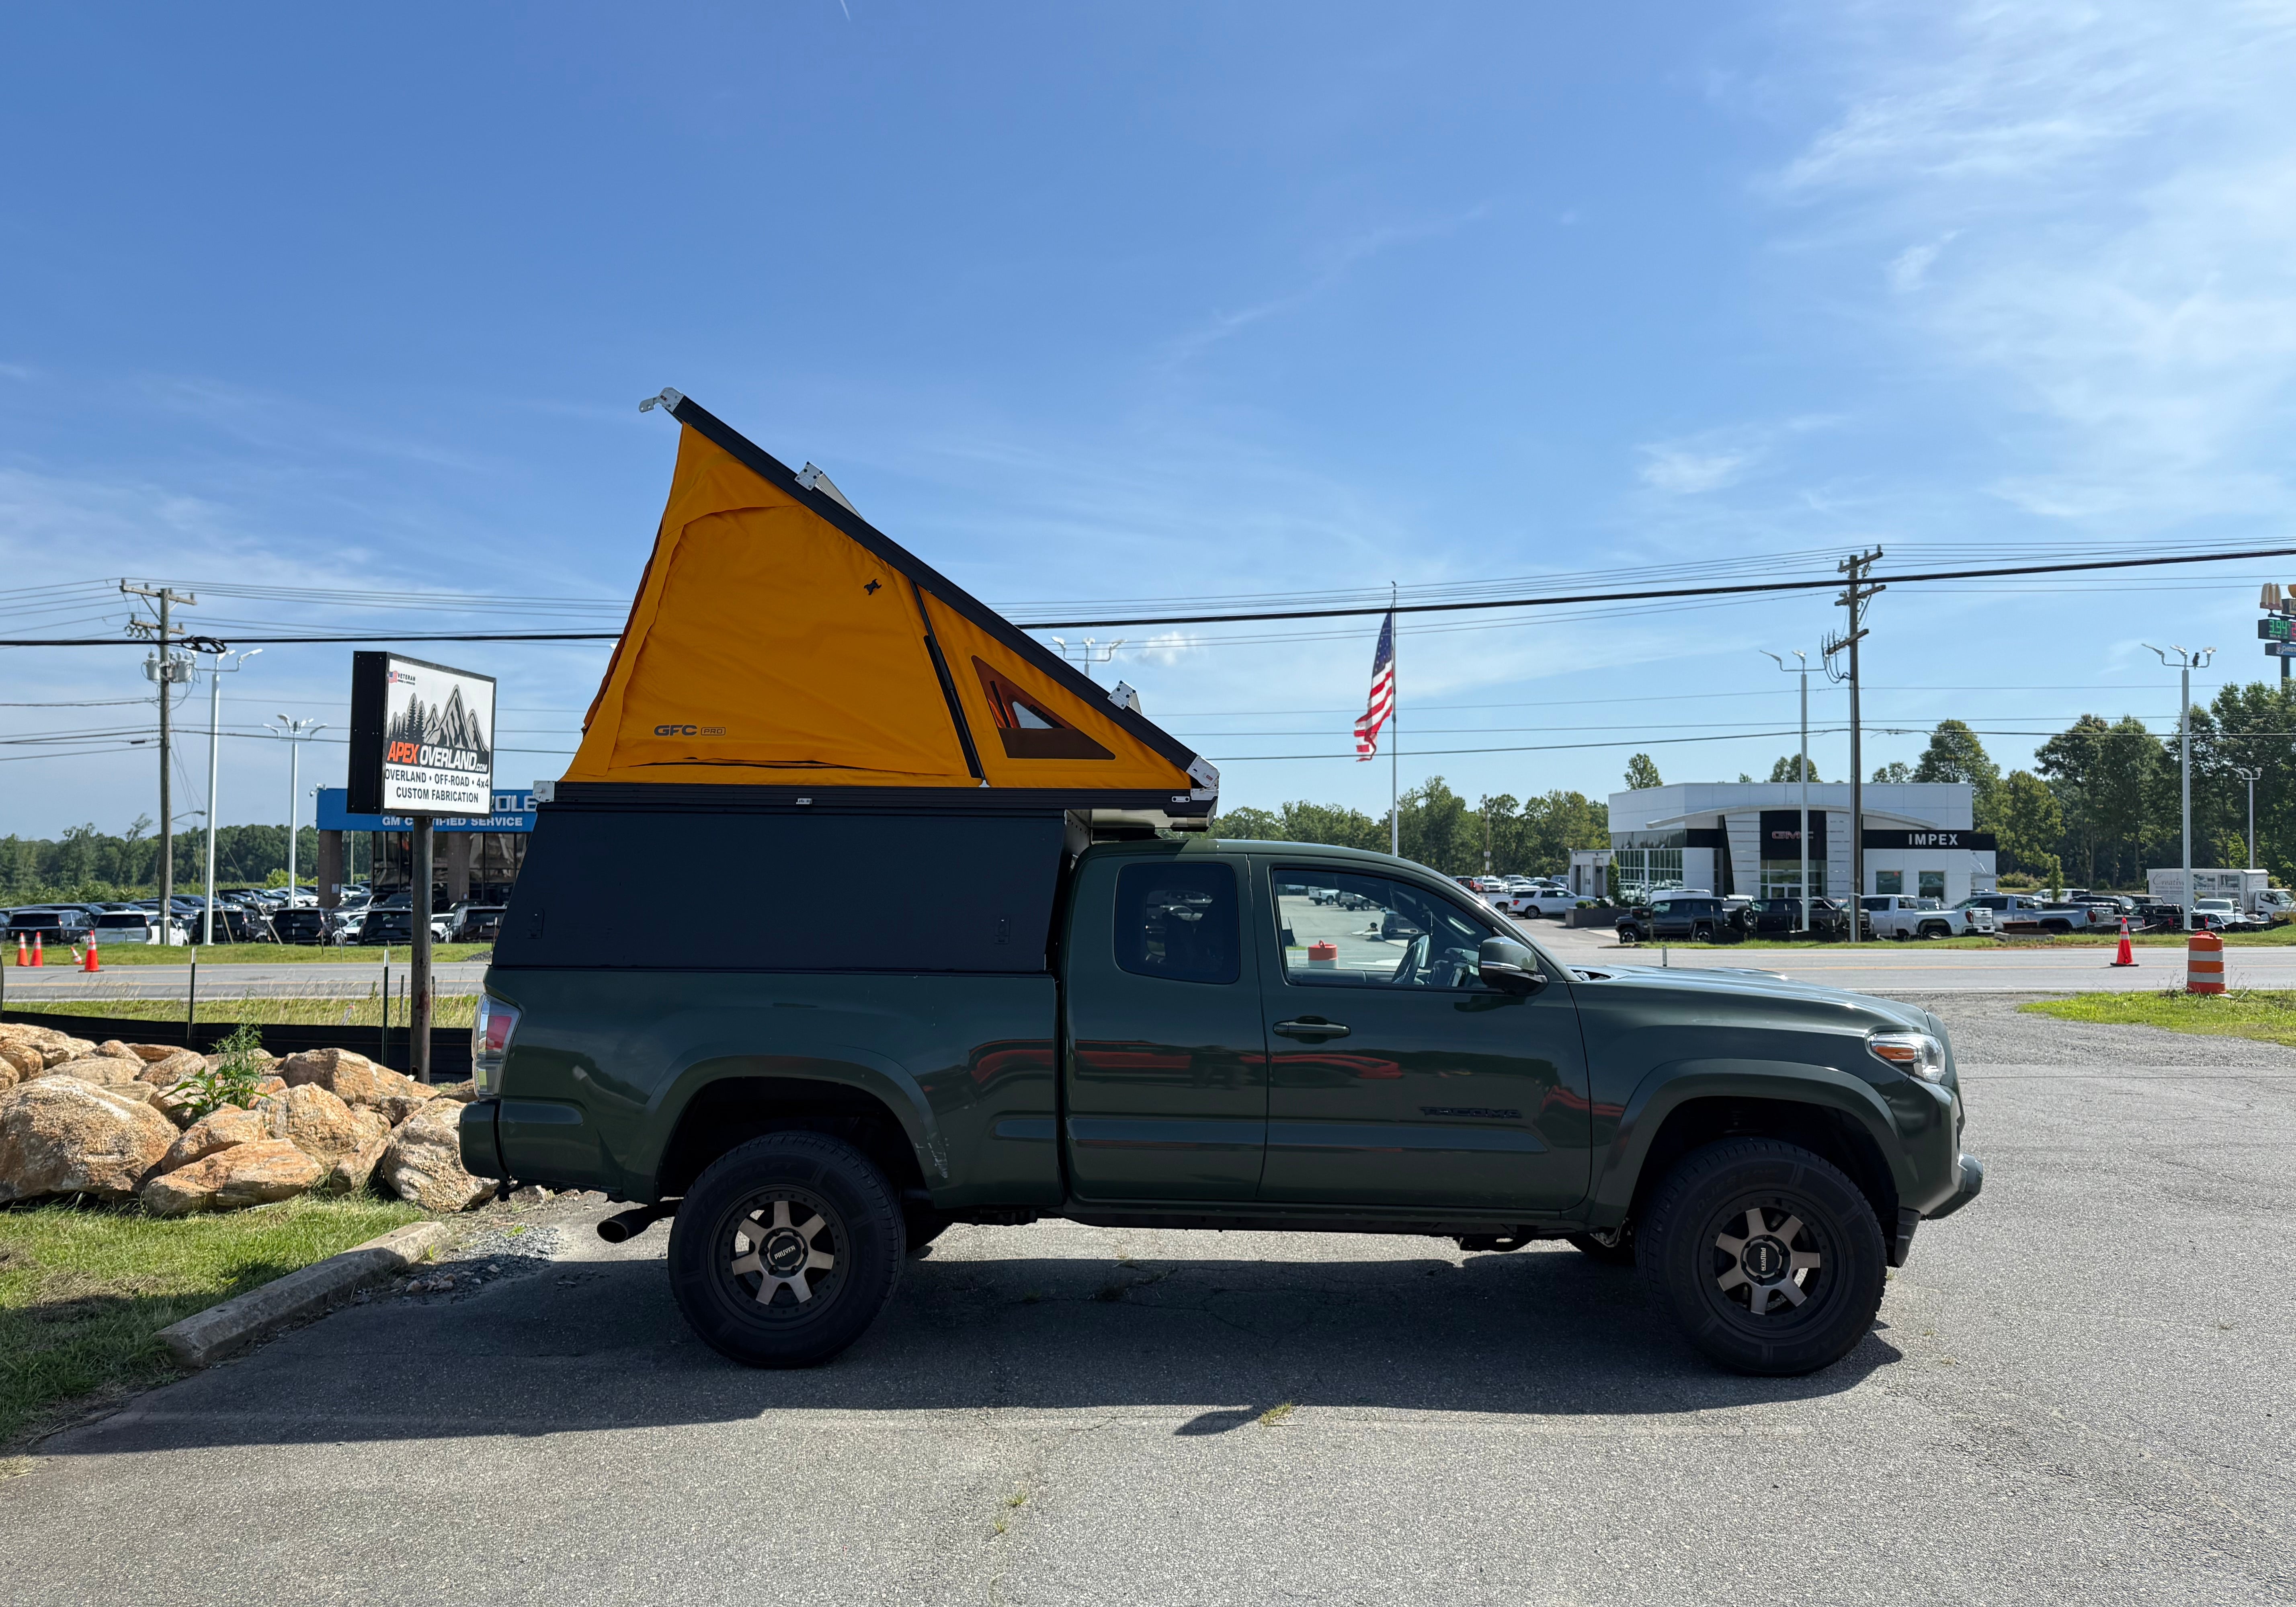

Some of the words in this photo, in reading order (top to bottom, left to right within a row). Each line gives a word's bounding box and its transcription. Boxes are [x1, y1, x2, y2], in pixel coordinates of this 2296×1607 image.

[398, 672, 416, 681] VETERAN
[654, 725, 697, 736] GFC
[387, 741, 420, 764] APEX
[420, 745, 488, 773] OVERLAND.COM
[385, 769, 426, 783] OVERLAND
[435, 773, 469, 787] OFF-ROAD
[477, 777, 489, 789] 4x4
[396, 787, 429, 800] CUSTOM
[432, 789, 478, 803] FABRICATION
[382, 816, 400, 826] GM
[404, 817, 466, 826] CTIFIED
[471, 817, 523, 826] SERVICE
[1909, 834, 1958, 845] IMPEX
[1419, 1107, 1522, 1119] TACOMA
